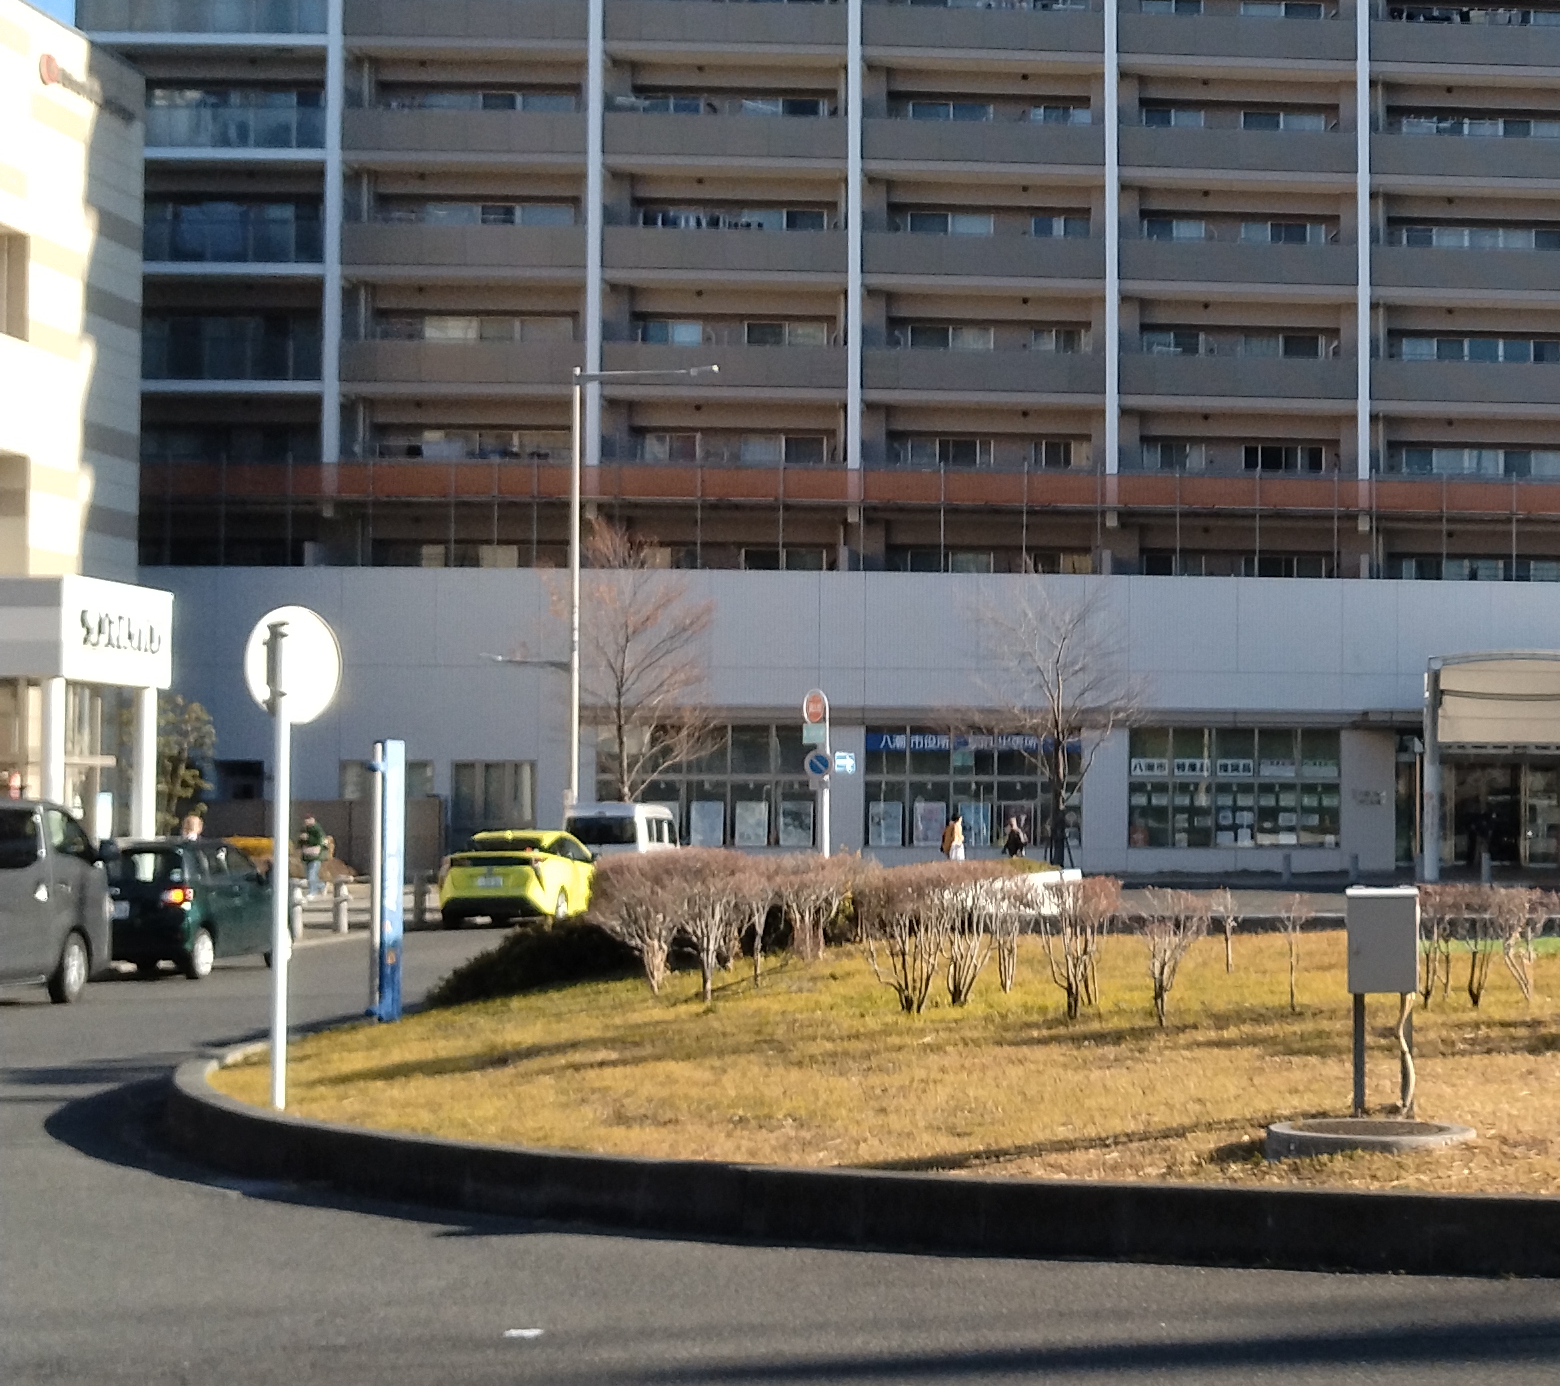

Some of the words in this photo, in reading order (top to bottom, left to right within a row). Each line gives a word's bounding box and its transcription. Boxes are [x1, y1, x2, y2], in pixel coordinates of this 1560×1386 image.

[880, 734, 950, 750] 八潮市役所
